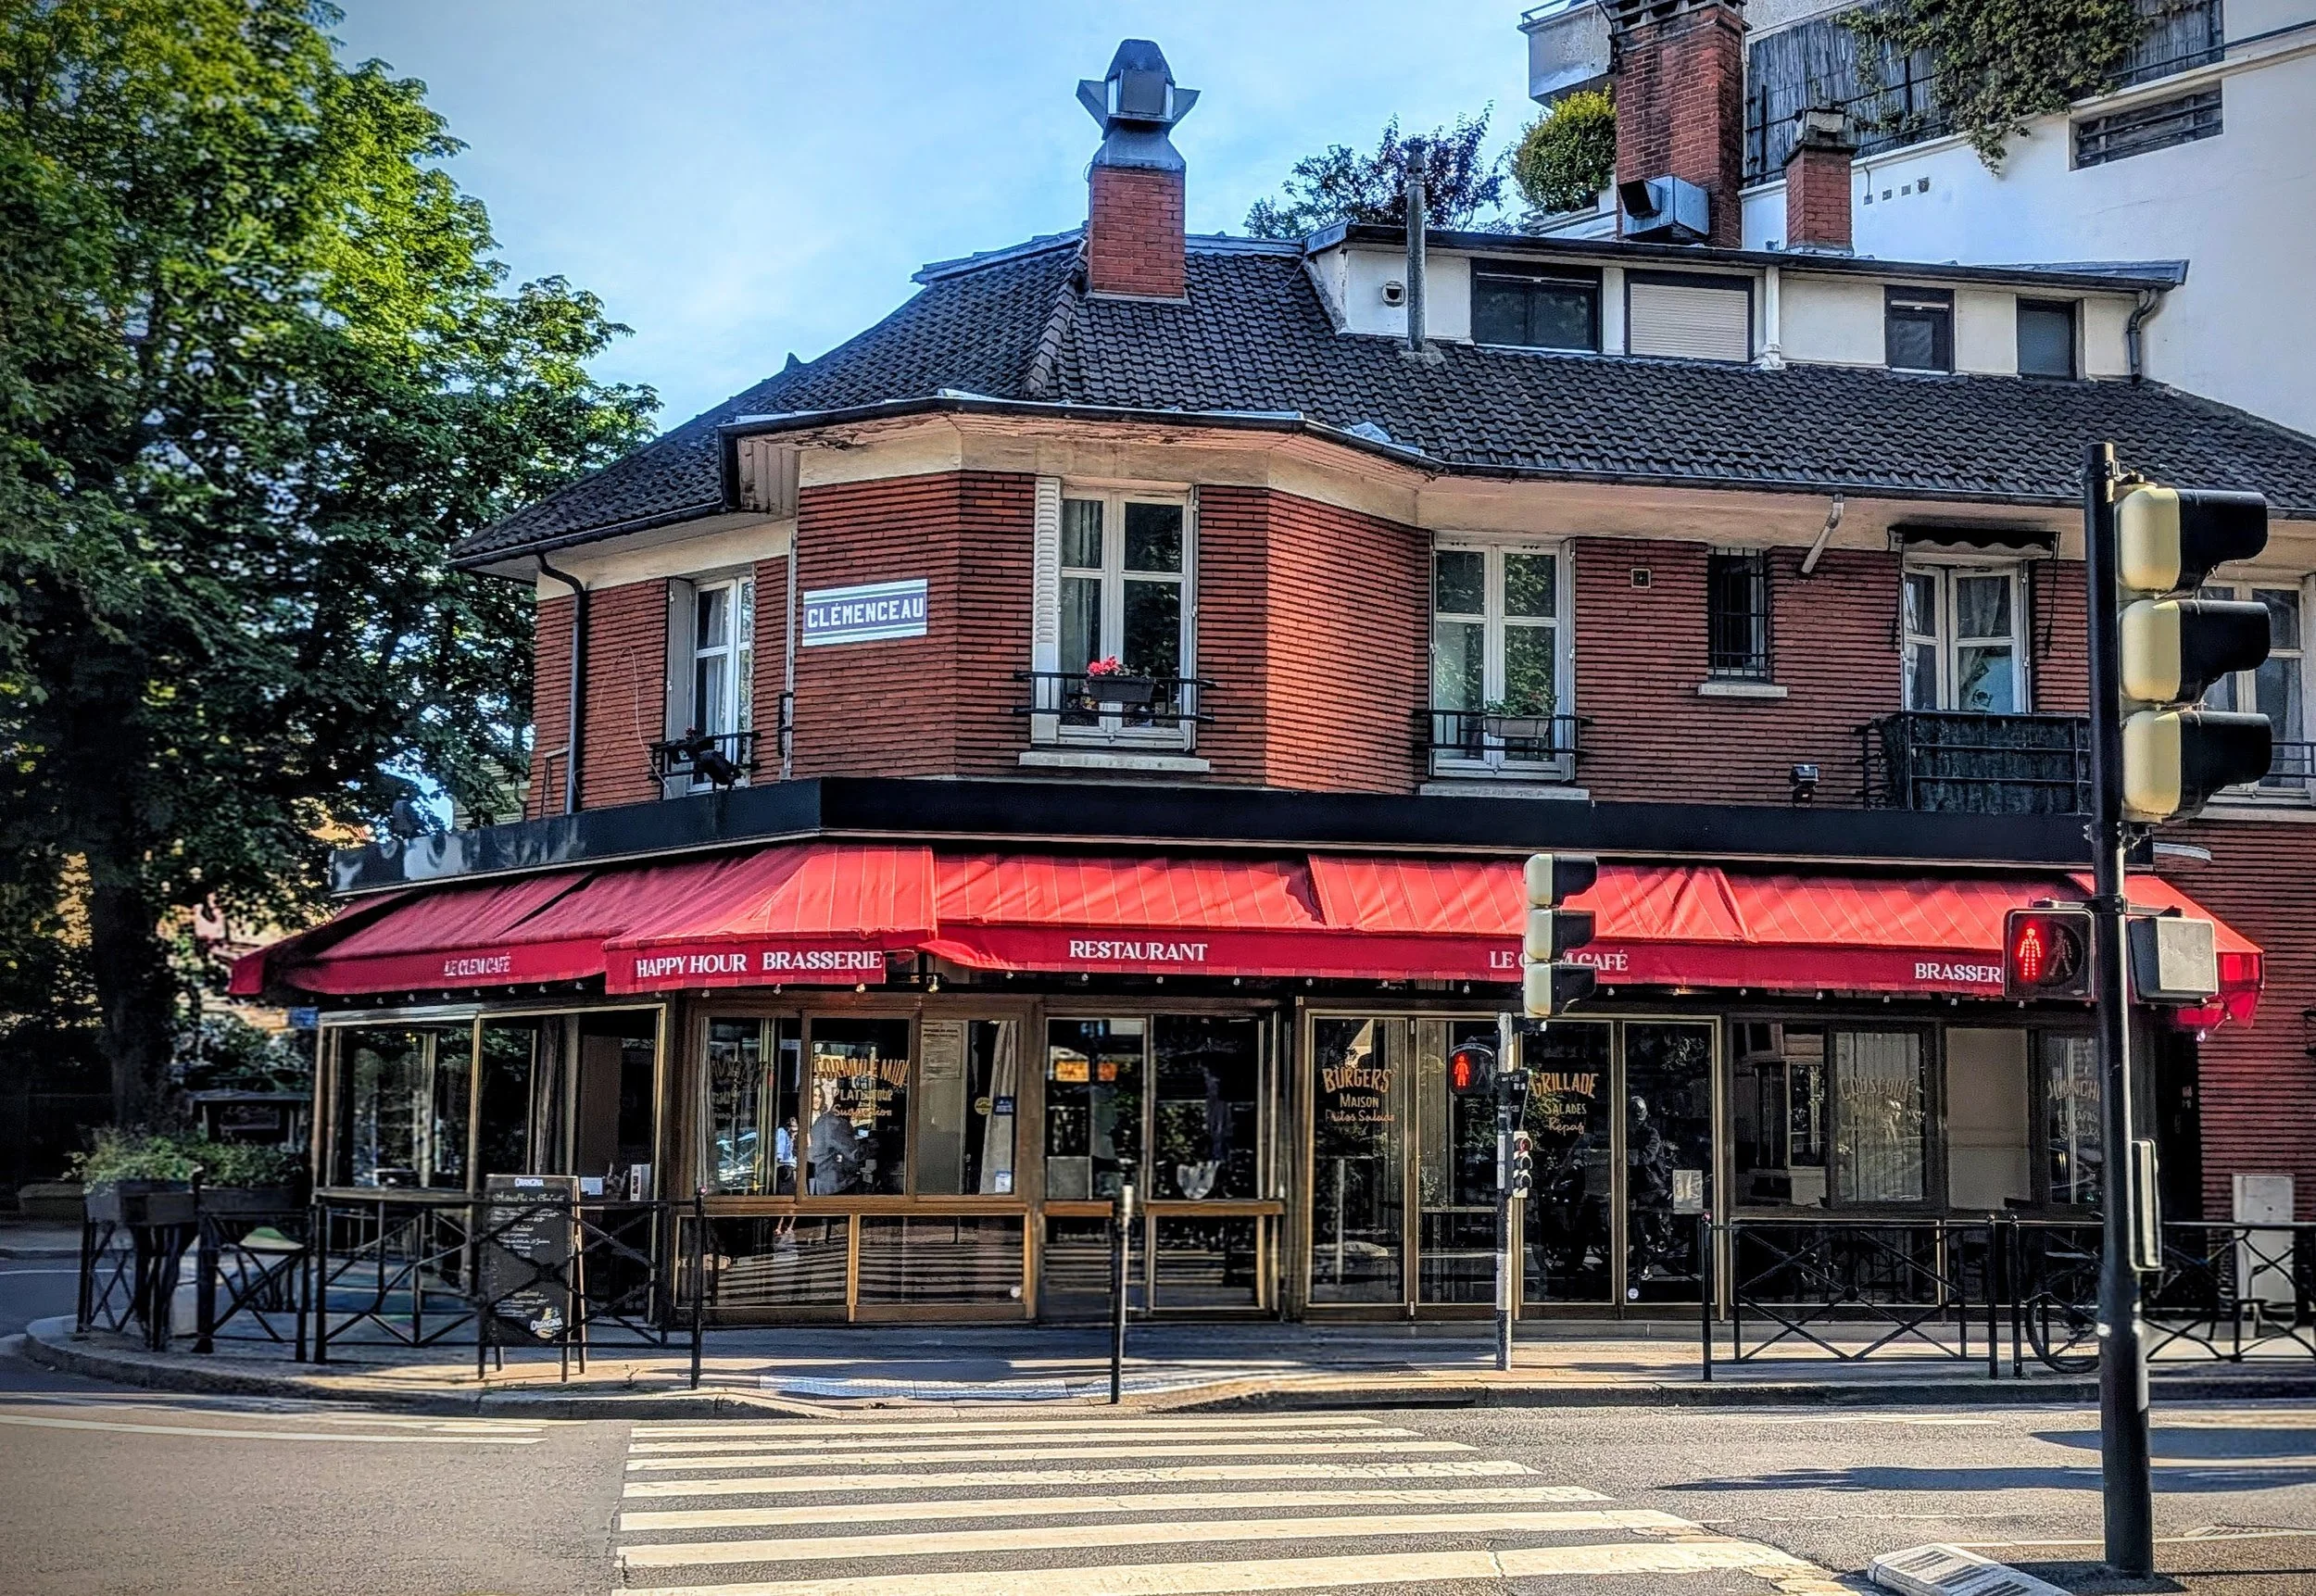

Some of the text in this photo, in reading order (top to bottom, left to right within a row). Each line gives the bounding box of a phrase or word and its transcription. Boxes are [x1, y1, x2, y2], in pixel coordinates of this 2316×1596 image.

[807, 597, 924, 628] CLÉMENCEAU
[1069, 939, 1208, 961] RESTAURANT
[1490, 950, 1515, 969] LE
[1578, 949, 1629, 972] CAFÉ
[636, 950, 883, 978] HAPPY HOUR BRASSERIE
[1915, 962, 2005, 984] BRASSER
[1322, 1067, 1392, 1093] BURGERS
